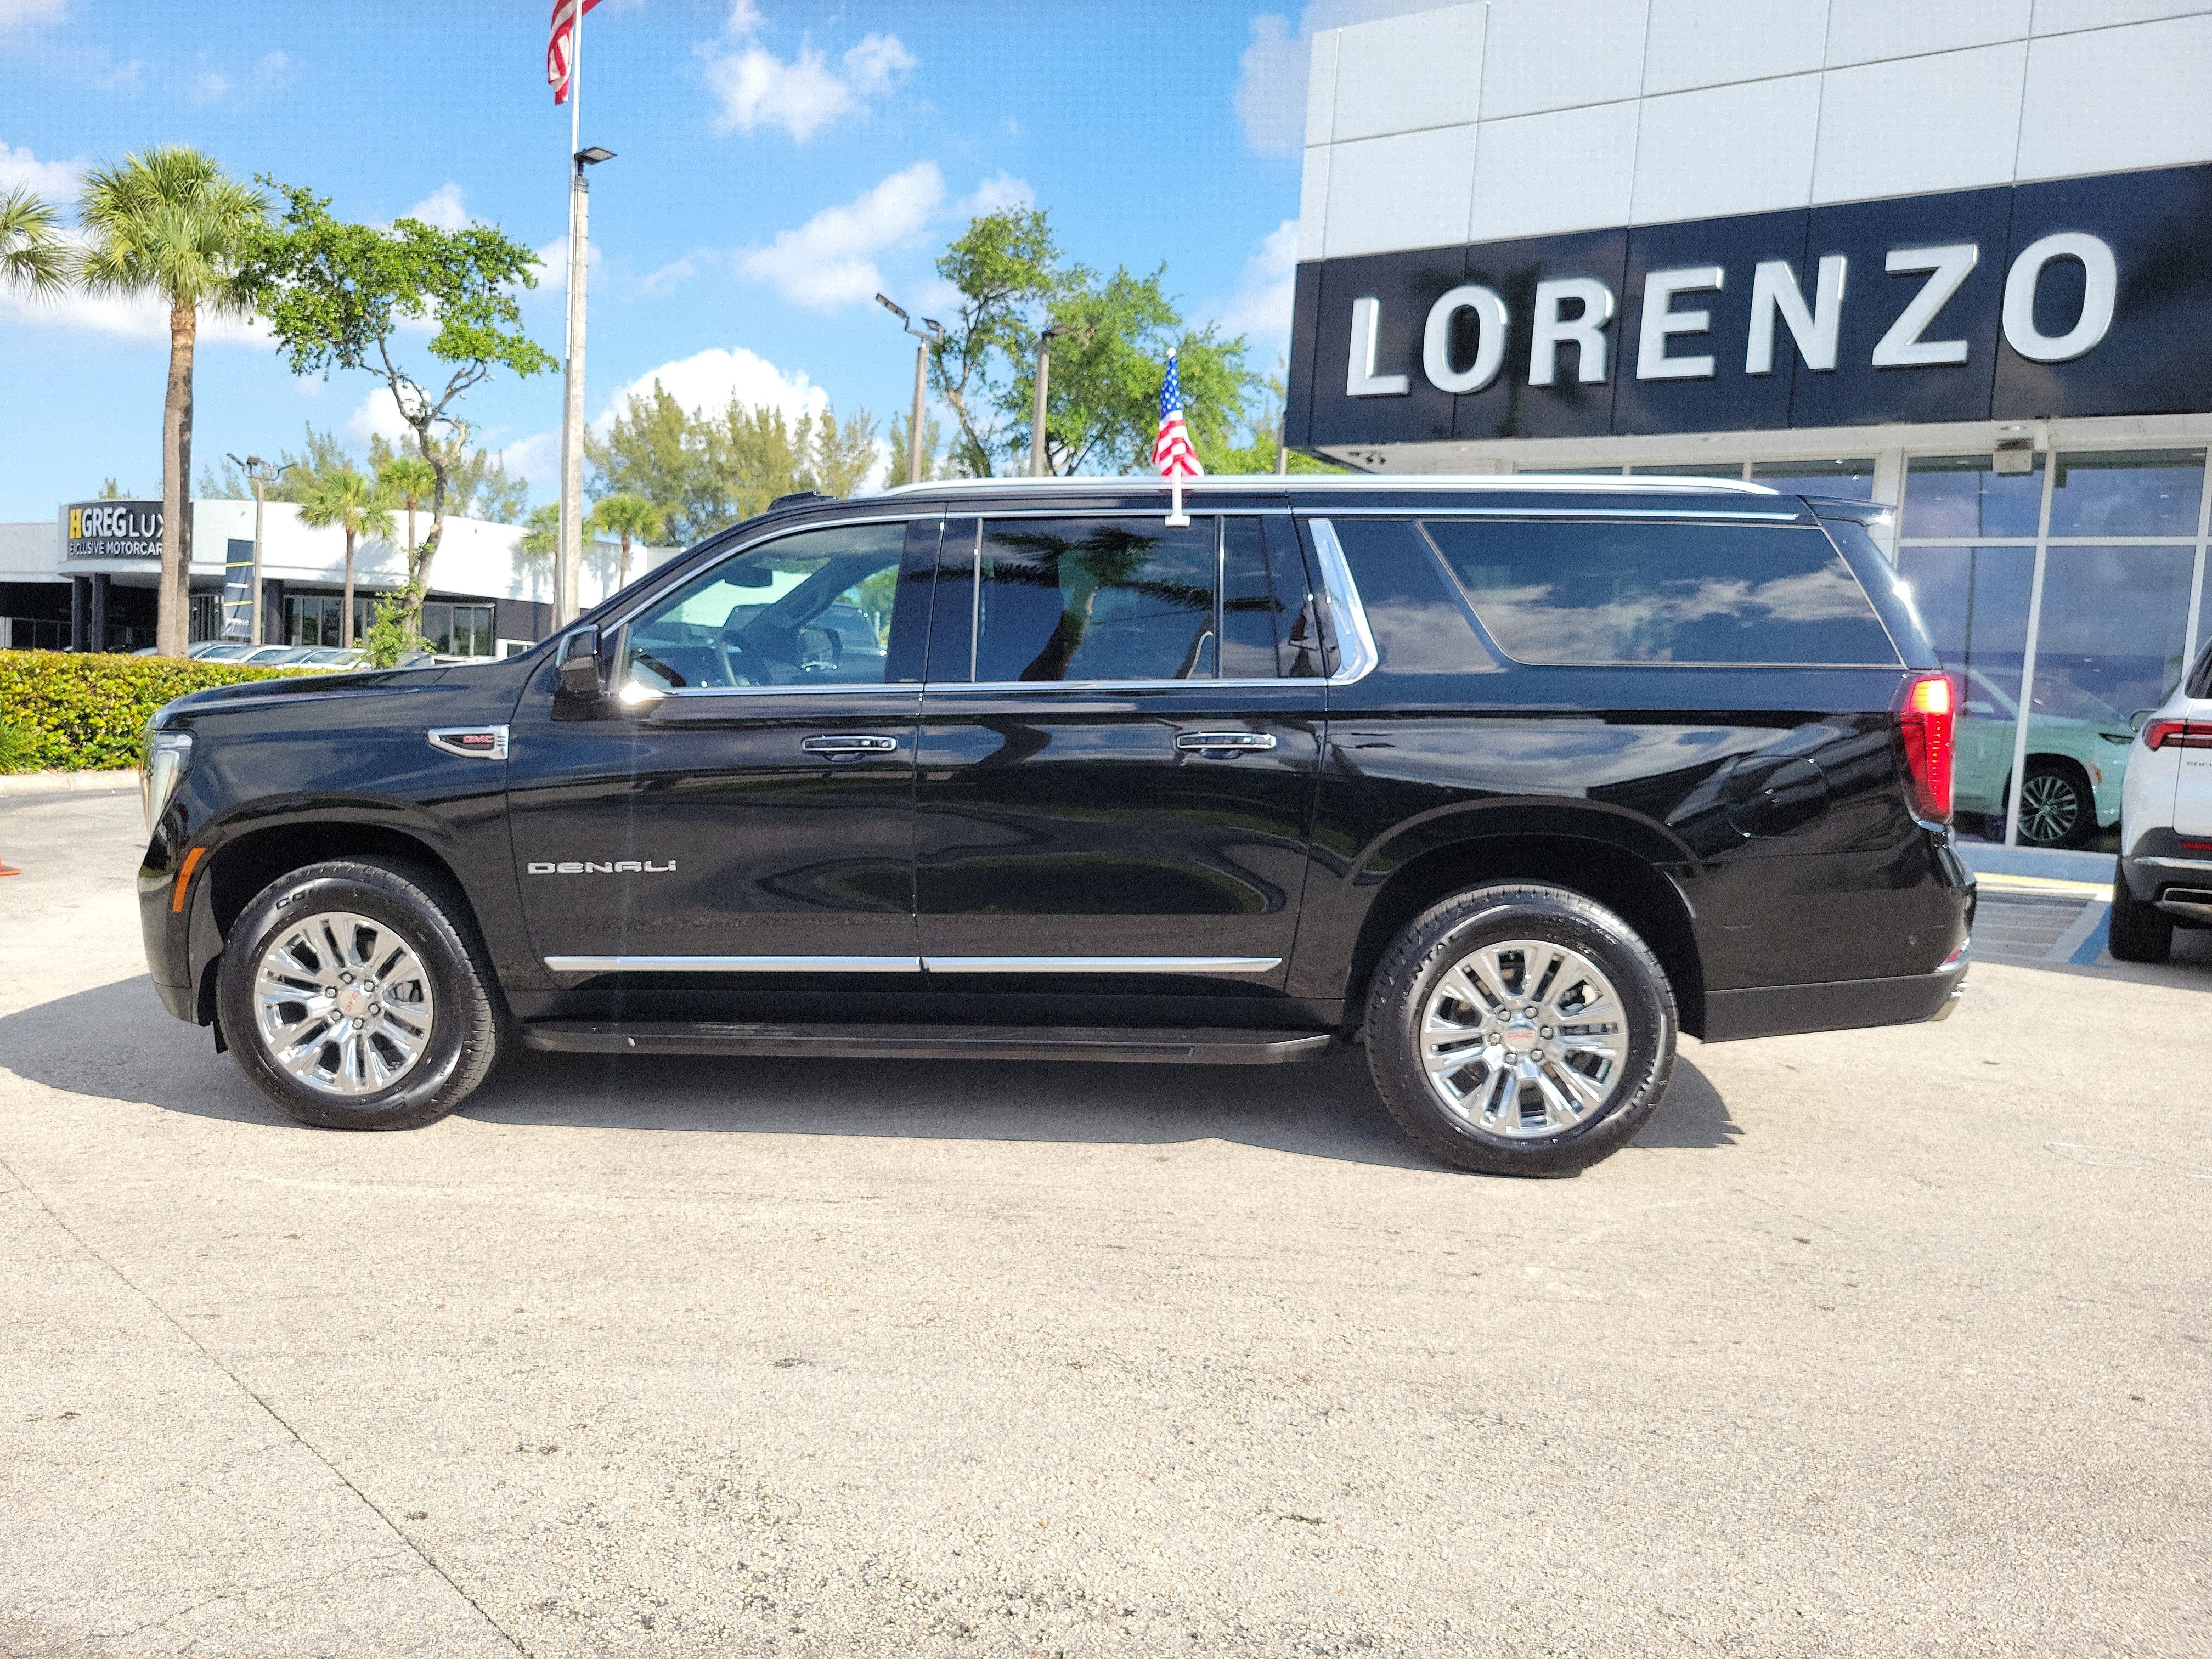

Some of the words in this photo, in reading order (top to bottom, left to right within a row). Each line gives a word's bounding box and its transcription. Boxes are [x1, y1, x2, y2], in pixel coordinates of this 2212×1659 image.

[1346, 232, 2117, 396] LORENZO
[106, 540, 163, 556] MOTORCAR
[462, 735, 494, 743] GMC
[527, 860, 677, 874] DENALI
